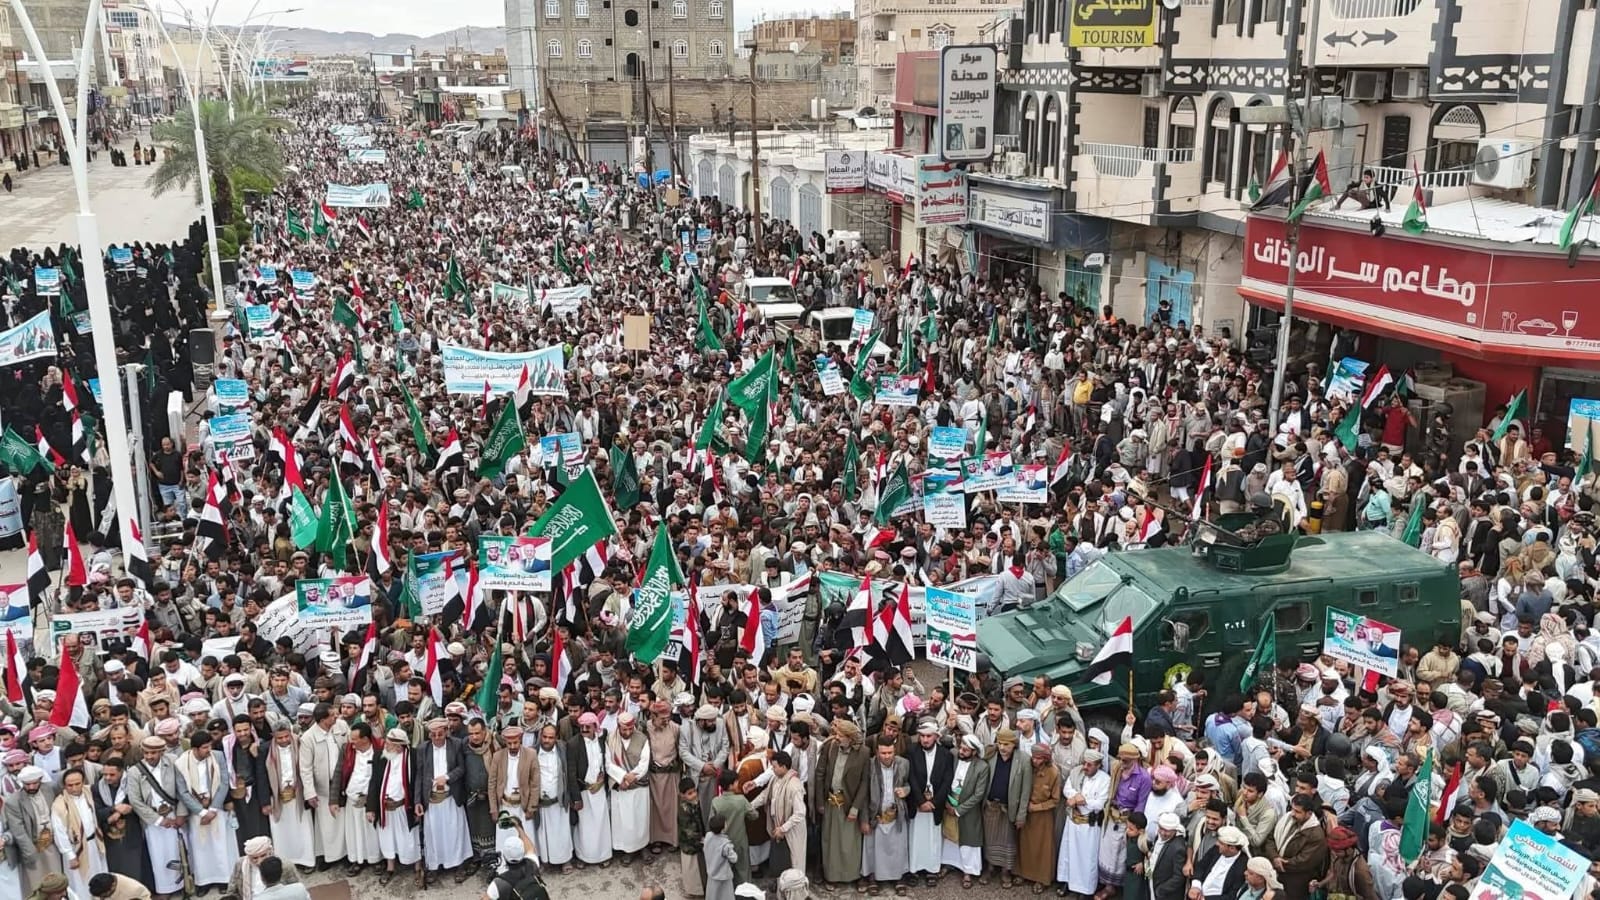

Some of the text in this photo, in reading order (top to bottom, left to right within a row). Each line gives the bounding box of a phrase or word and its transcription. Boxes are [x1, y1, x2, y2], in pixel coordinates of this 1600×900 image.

[1082, 31, 1146, 44] TOURISM
[959, 53, 982, 64] مركز
[951, 69, 988, 81] هدنة
[949, 89, 989, 103] للجوالات
[1253, 237, 1476, 308] مطاعم سر المذاق
